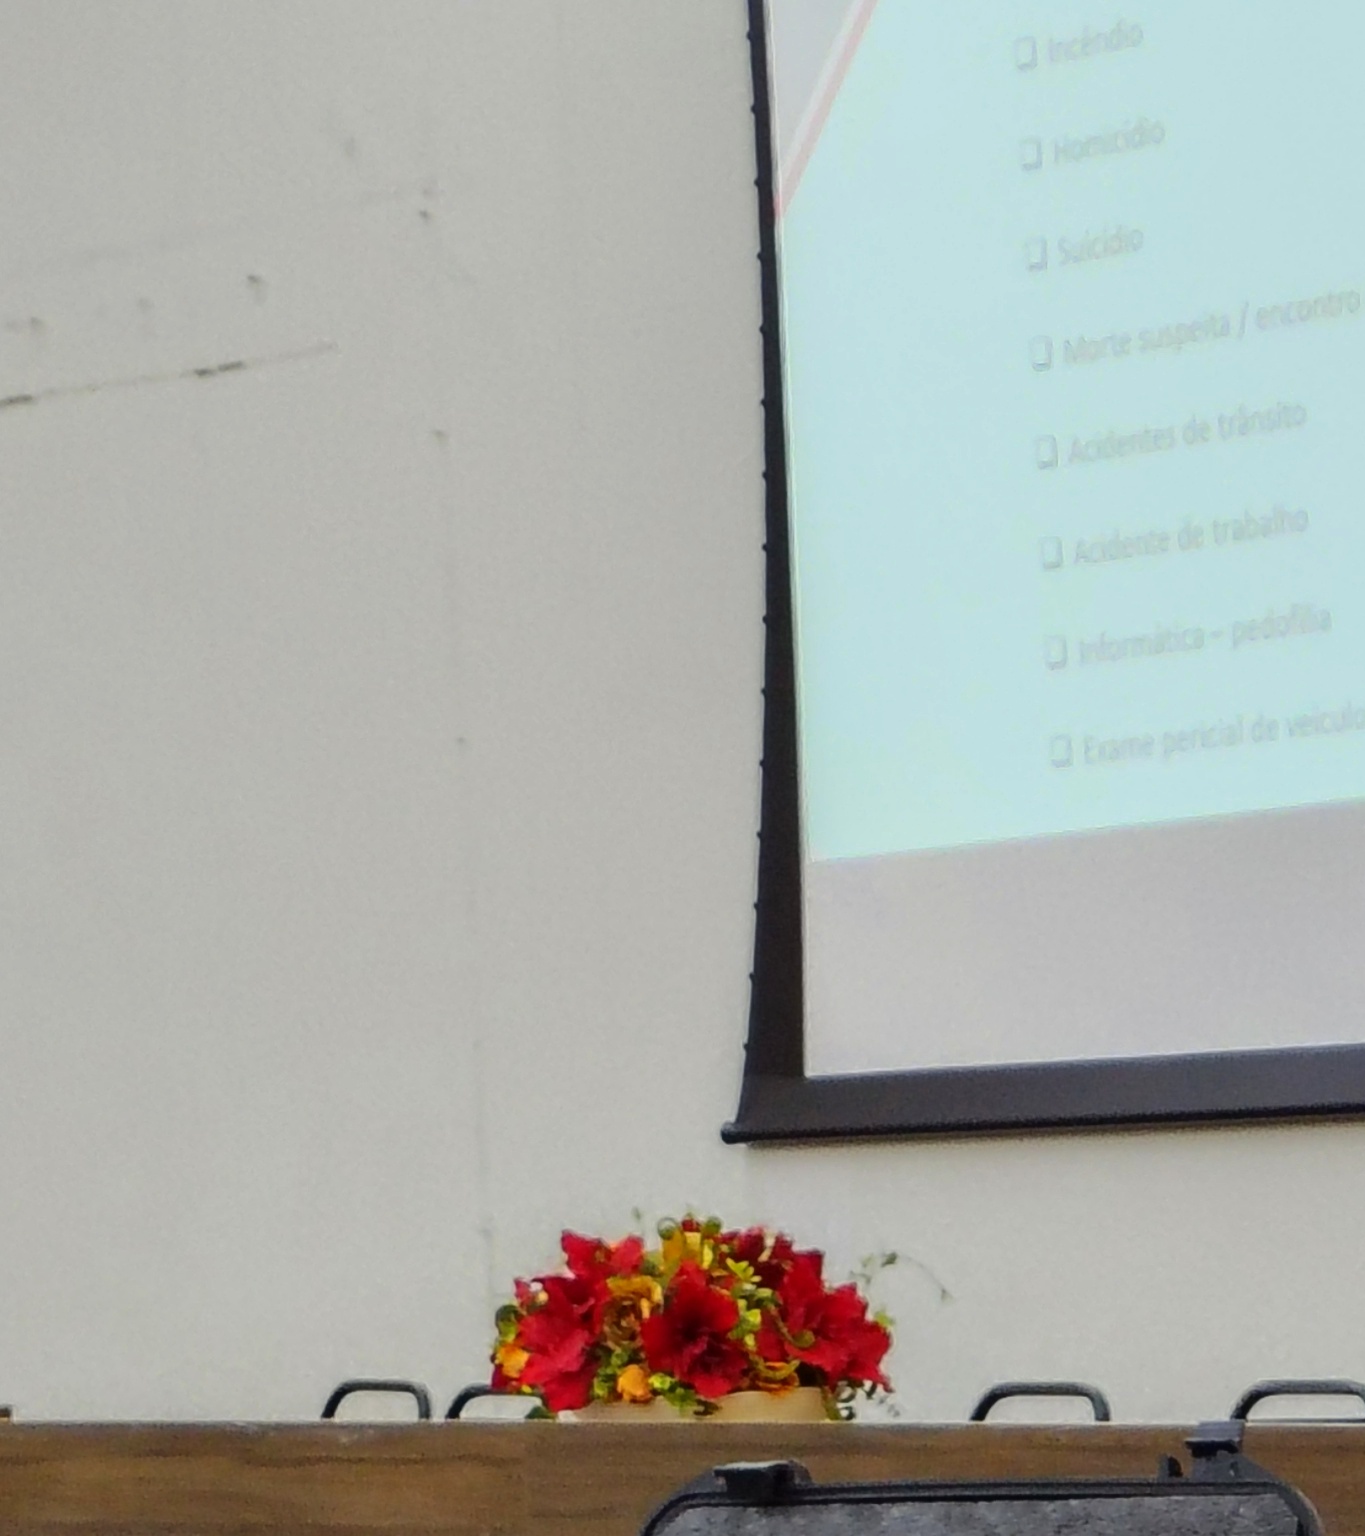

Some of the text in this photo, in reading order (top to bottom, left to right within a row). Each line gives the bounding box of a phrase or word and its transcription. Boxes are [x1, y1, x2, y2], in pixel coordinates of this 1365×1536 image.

[1063, 332, 1131, 364] Morte
[1255, 289, 1360, 331] encontro
[1068, 421, 1175, 466] Acidentes
[1183, 414, 1210, 446] de
[1074, 502, 1310, 565] Acidente de trabalho
[1083, 729, 1155, 766] Exame
[1161, 717, 1245, 761] pericial
[1250, 713, 1280, 744] de
